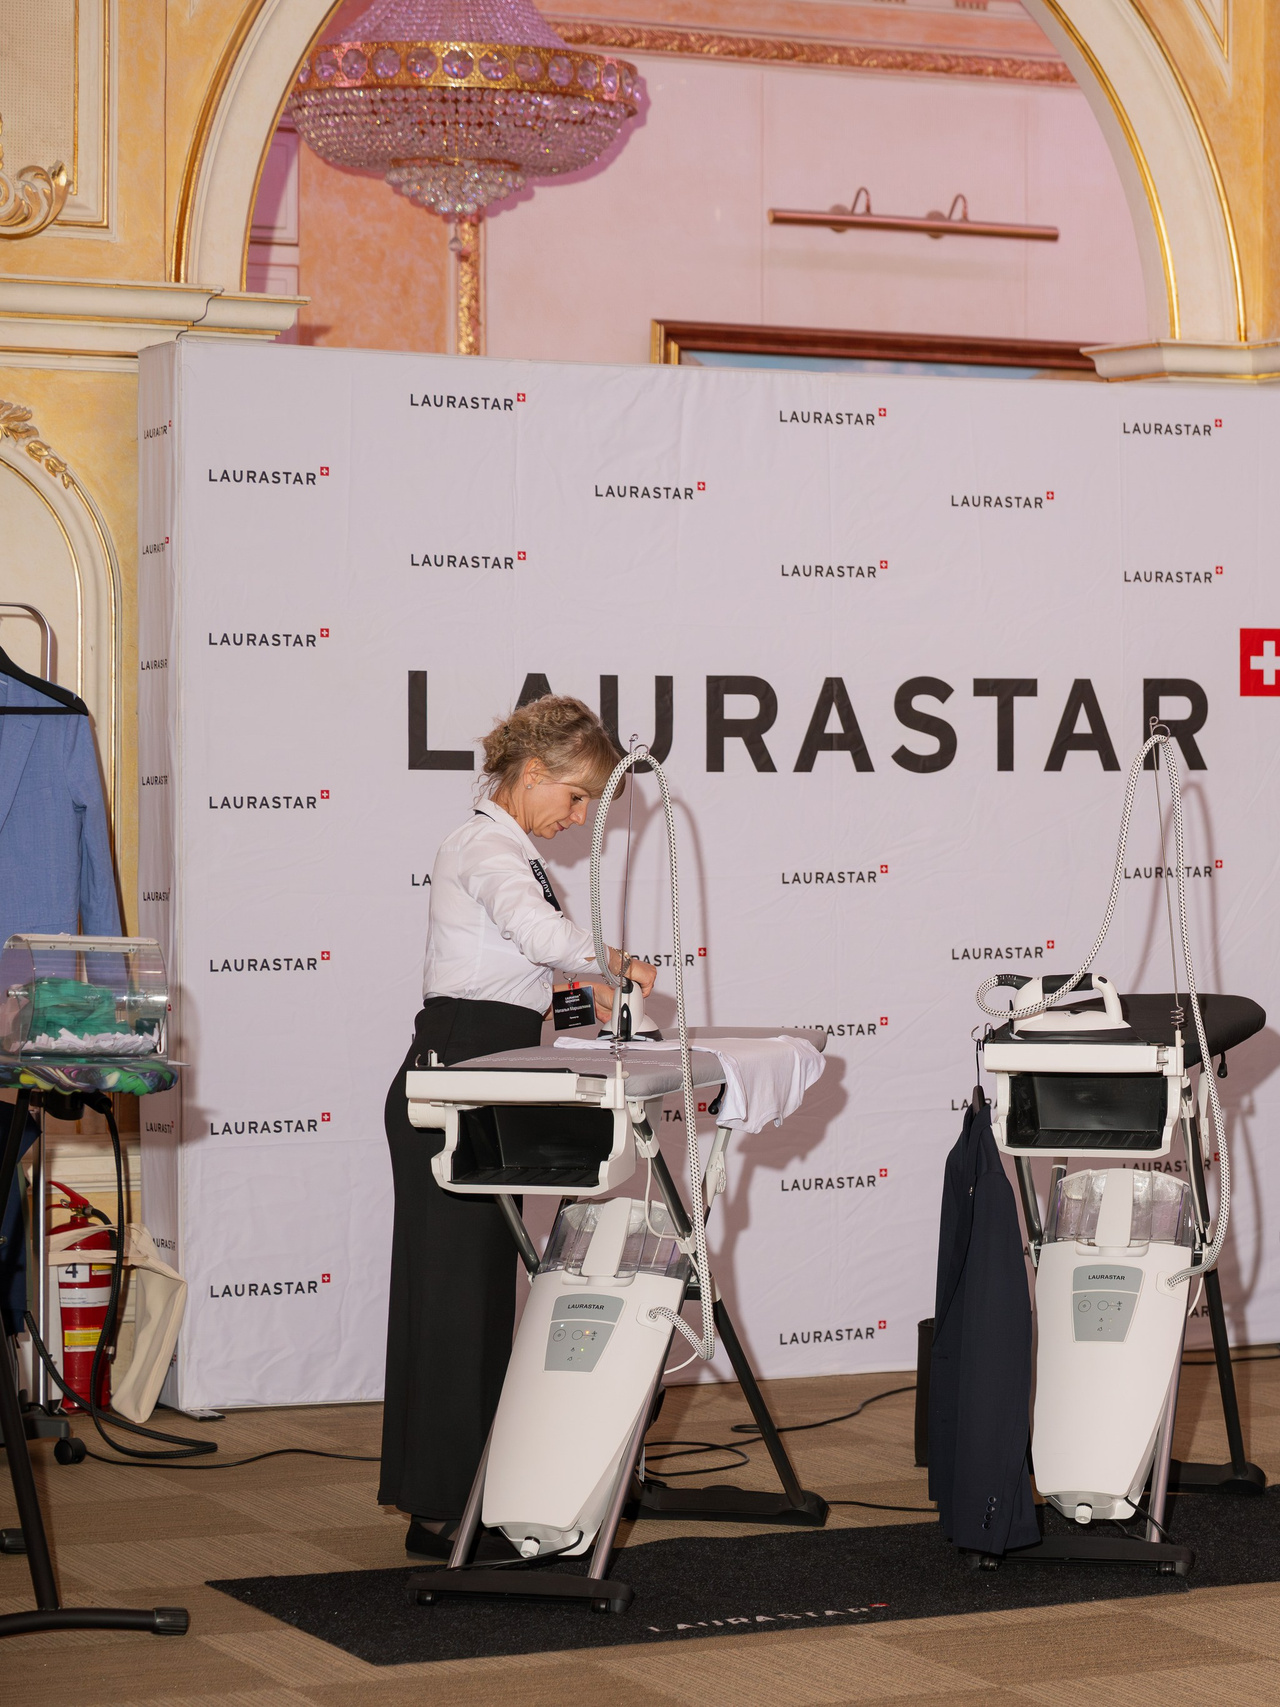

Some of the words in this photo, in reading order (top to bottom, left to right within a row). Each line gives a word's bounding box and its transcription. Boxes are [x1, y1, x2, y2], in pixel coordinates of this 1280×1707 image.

[411, 394, 513, 410] LAURASTAR
[780, 411, 874, 425] LAURASTAR
[1123, 423, 1211, 436] LAURASTAR
[209, 469, 316, 485] LAURASTAR
[595, 485, 693, 499] LAURASTAR
[952, 496, 1043, 508] LAURASTAR
[411, 554, 513, 569] LAURASTAR
[782, 565, 876, 578] LAURASTAR
[1124, 571, 1212, 583] LAURASTAR
[209, 633, 316, 647] LAURASTAR
[209, 796, 316, 809] LAURASTAR
[782, 871, 876, 884] LAURASTAR
[1124, 866, 1213, 879] LAURATAR
[952, 947, 1043, 960] LAURASTAR
[210, 958, 317, 972] LAURASTAR
[210, 1119, 318, 1136] LAURASTAR
[782, 1175, 876, 1191] LAURASTAR
[65, 1263, 78, 1278] 4
[211, 1281, 317, 1298] LAURASTAR
[567, 1303, 605, 1311] LAURASTAR
[780, 1327, 874, 1345] LAURASTAR
